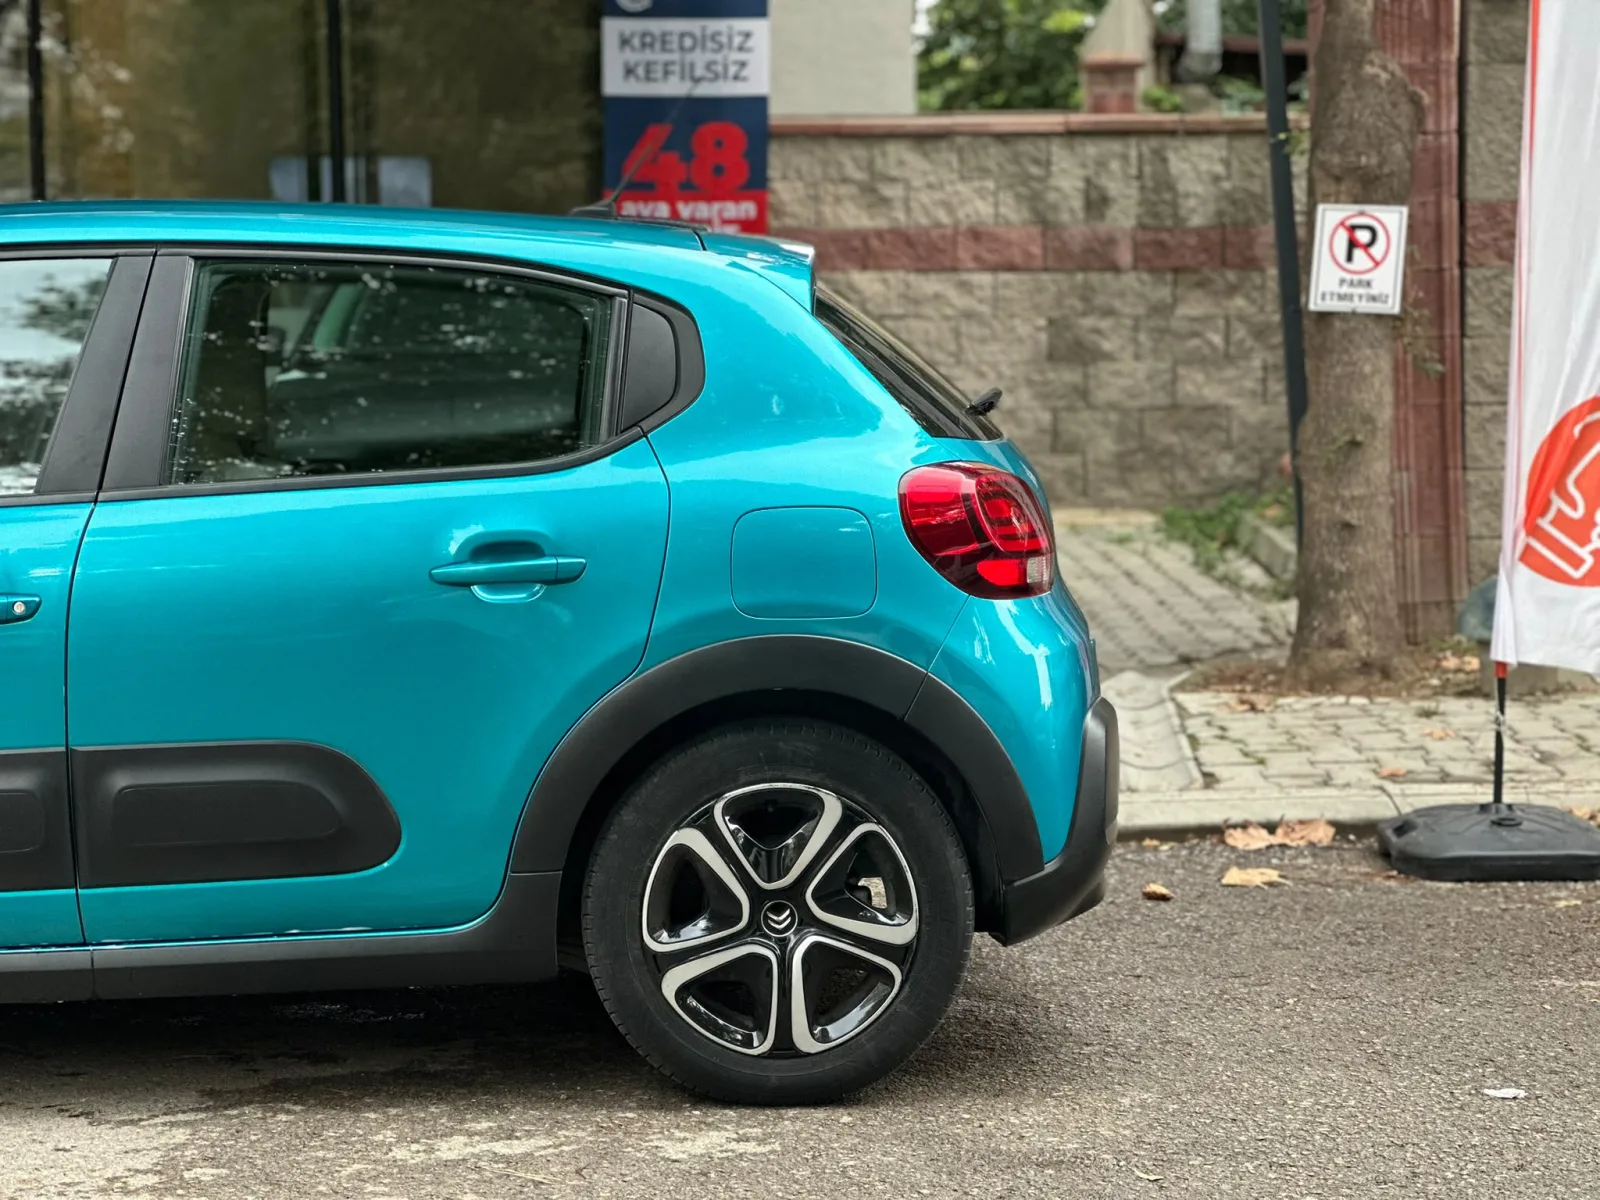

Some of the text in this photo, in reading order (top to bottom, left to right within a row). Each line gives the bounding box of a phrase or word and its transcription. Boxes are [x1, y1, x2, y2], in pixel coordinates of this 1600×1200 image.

[618, 25, 754, 54] KREDİSİZ
[622, 55, 750, 83] KEFİLSİZ
[621, 121, 750, 194] 48
[676, 201, 758, 220] varan
[1338, 278, 1373, 289] PARK
